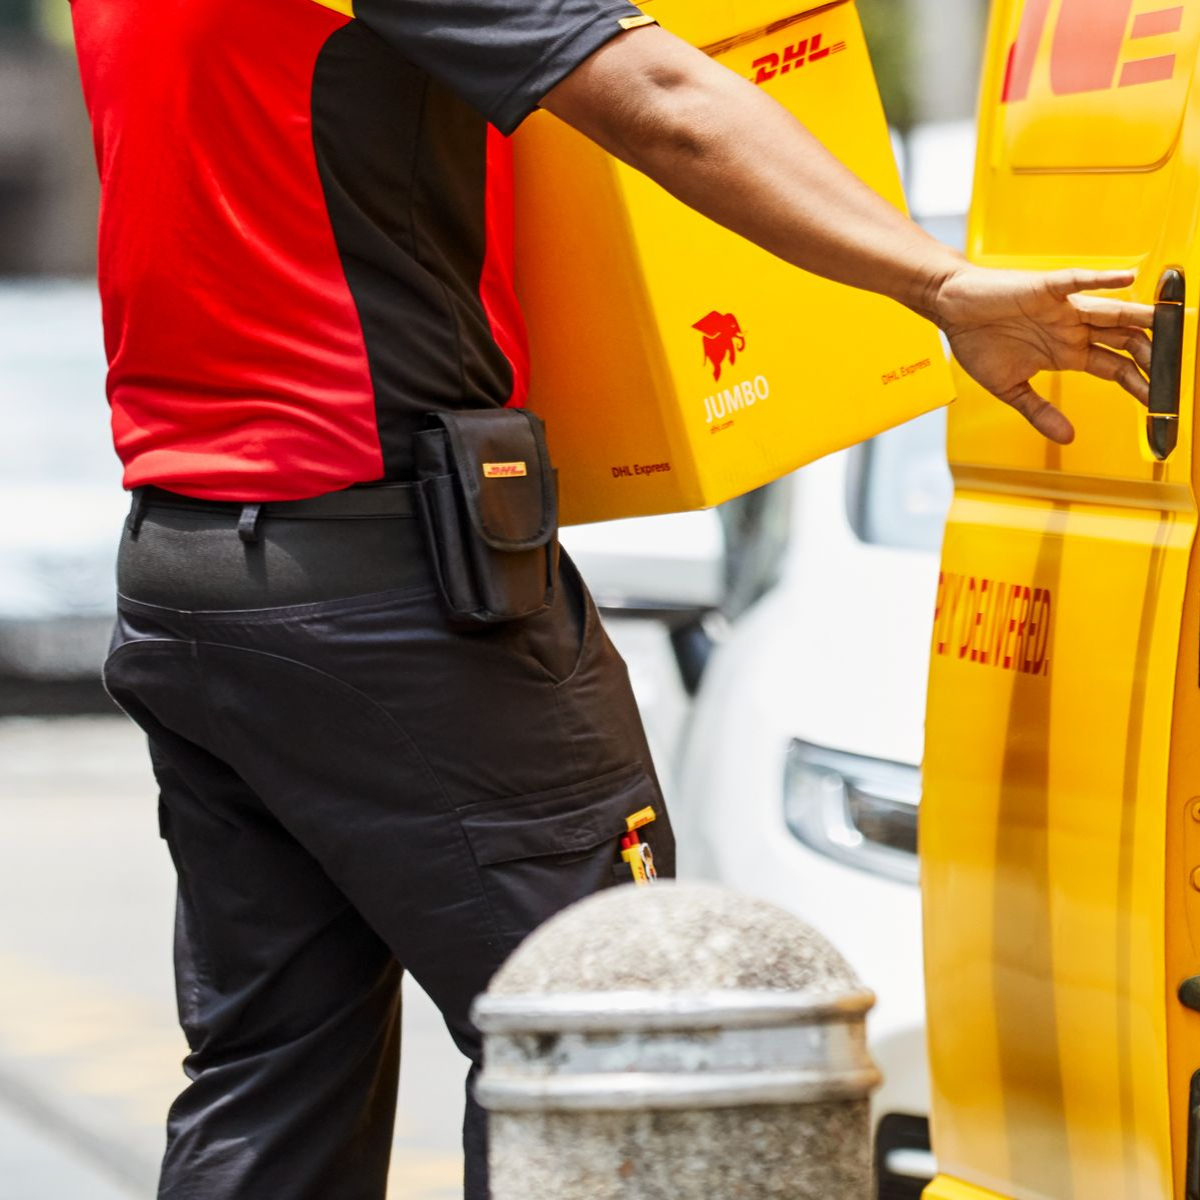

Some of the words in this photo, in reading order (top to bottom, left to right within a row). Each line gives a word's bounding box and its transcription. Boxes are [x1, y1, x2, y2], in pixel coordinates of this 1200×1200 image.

[752, 33, 830, 85] DHL
[881, 370, 900, 385] DHL
[900, 358, 931, 377] Express
[704, 375, 769, 424] JUMBO
[611, 465, 633, 478] DHL
[634, 462, 671, 477] Express
